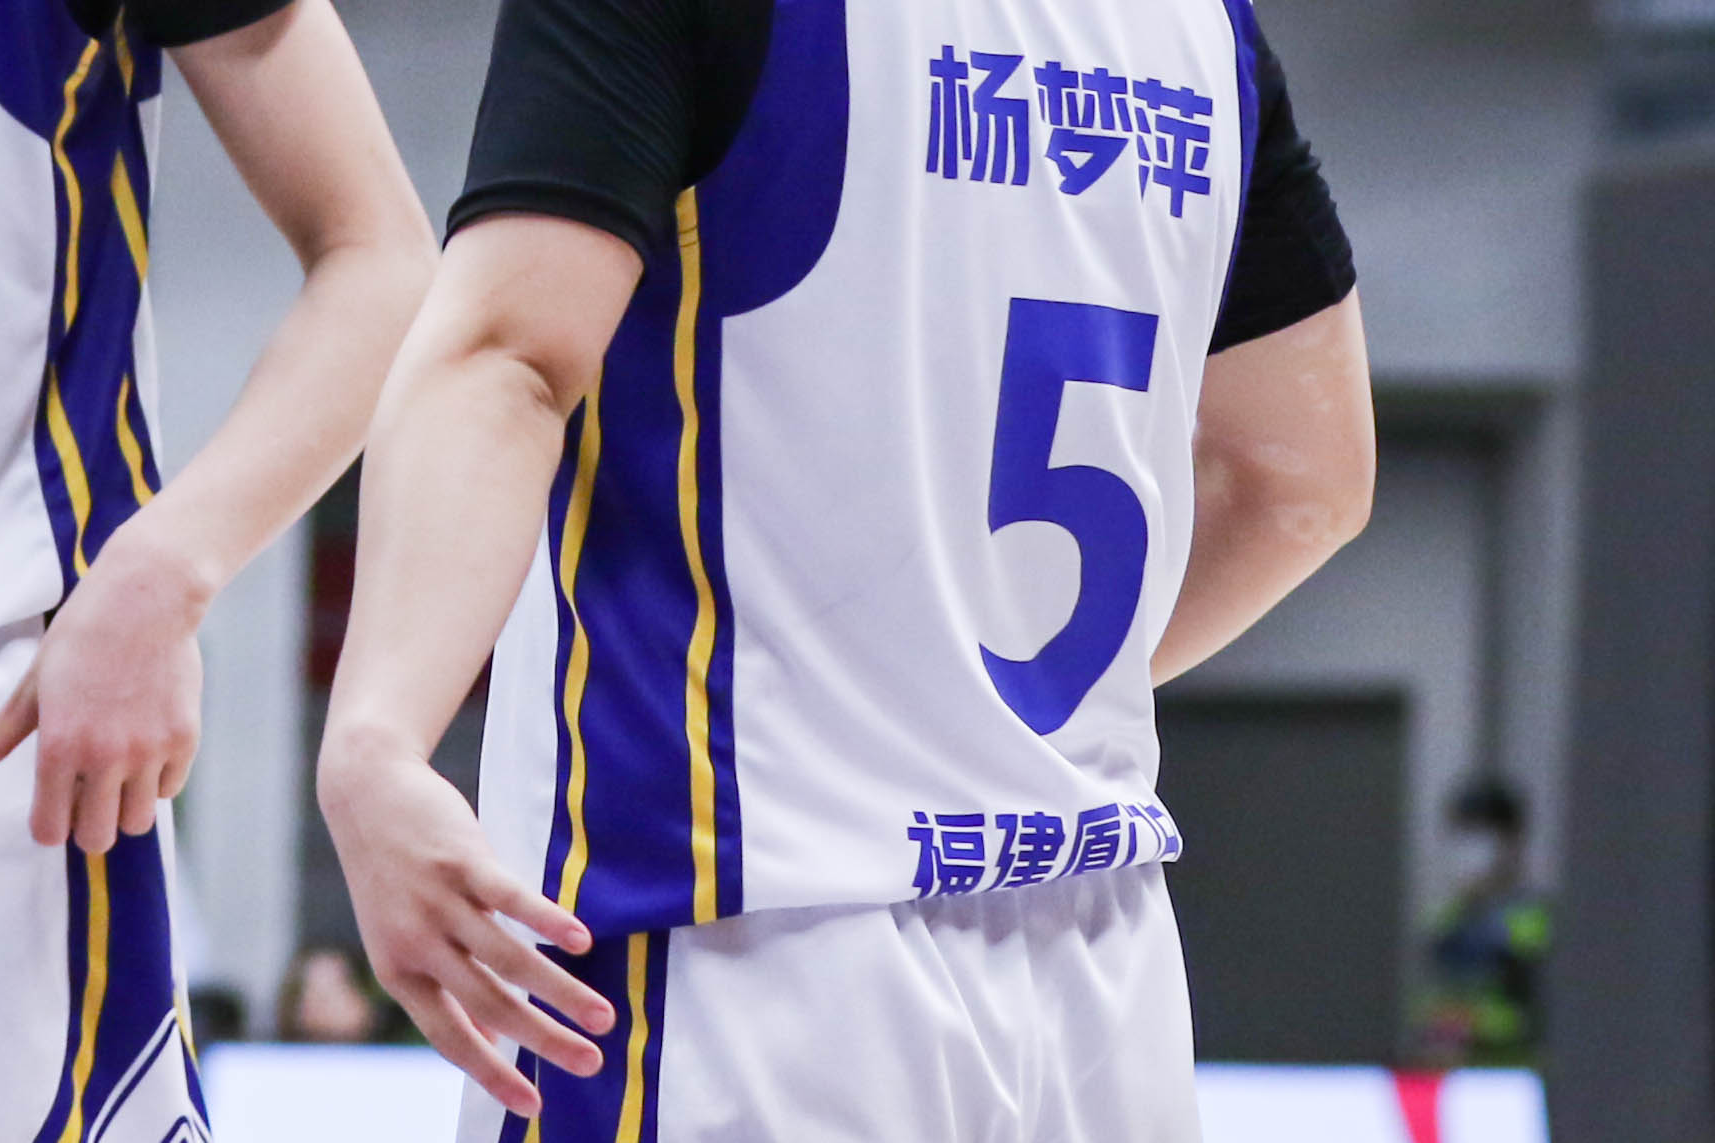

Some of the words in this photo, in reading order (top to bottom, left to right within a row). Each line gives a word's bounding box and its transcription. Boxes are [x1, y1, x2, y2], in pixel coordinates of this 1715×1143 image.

[926, 45, 1214, 218] 杨梦萍
[979, 297, 1158, 736] 5
